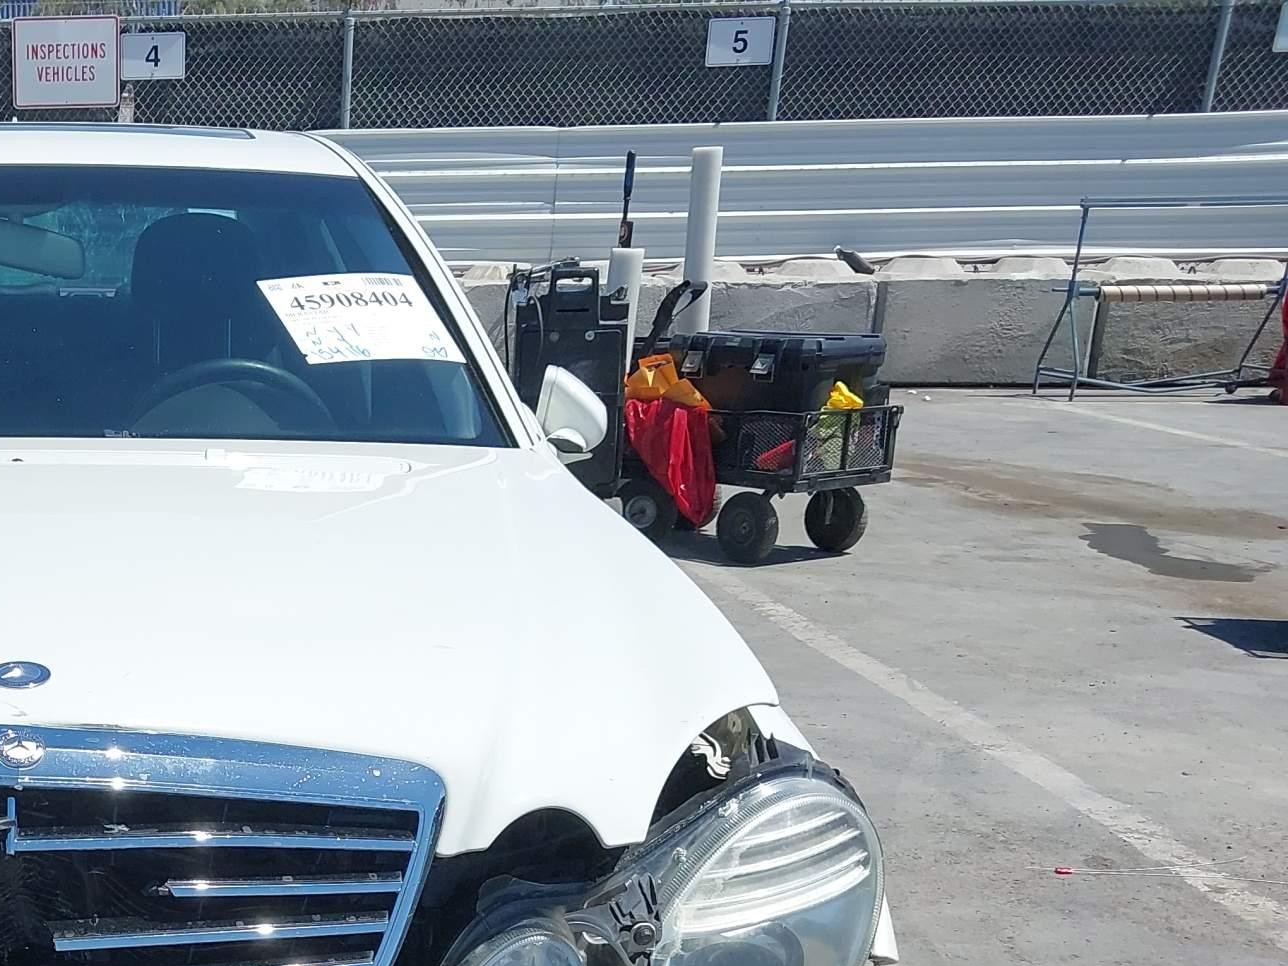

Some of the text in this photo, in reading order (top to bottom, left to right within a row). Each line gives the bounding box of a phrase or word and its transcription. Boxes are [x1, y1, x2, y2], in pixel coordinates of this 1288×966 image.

[26, 42, 107, 60] INSPECTIONS
[732, 29, 749, 54] 5
[144, 45, 161, 68] 4
[37, 65, 96, 82] VEHICLES
[290, 290, 413, 311] 45908404
